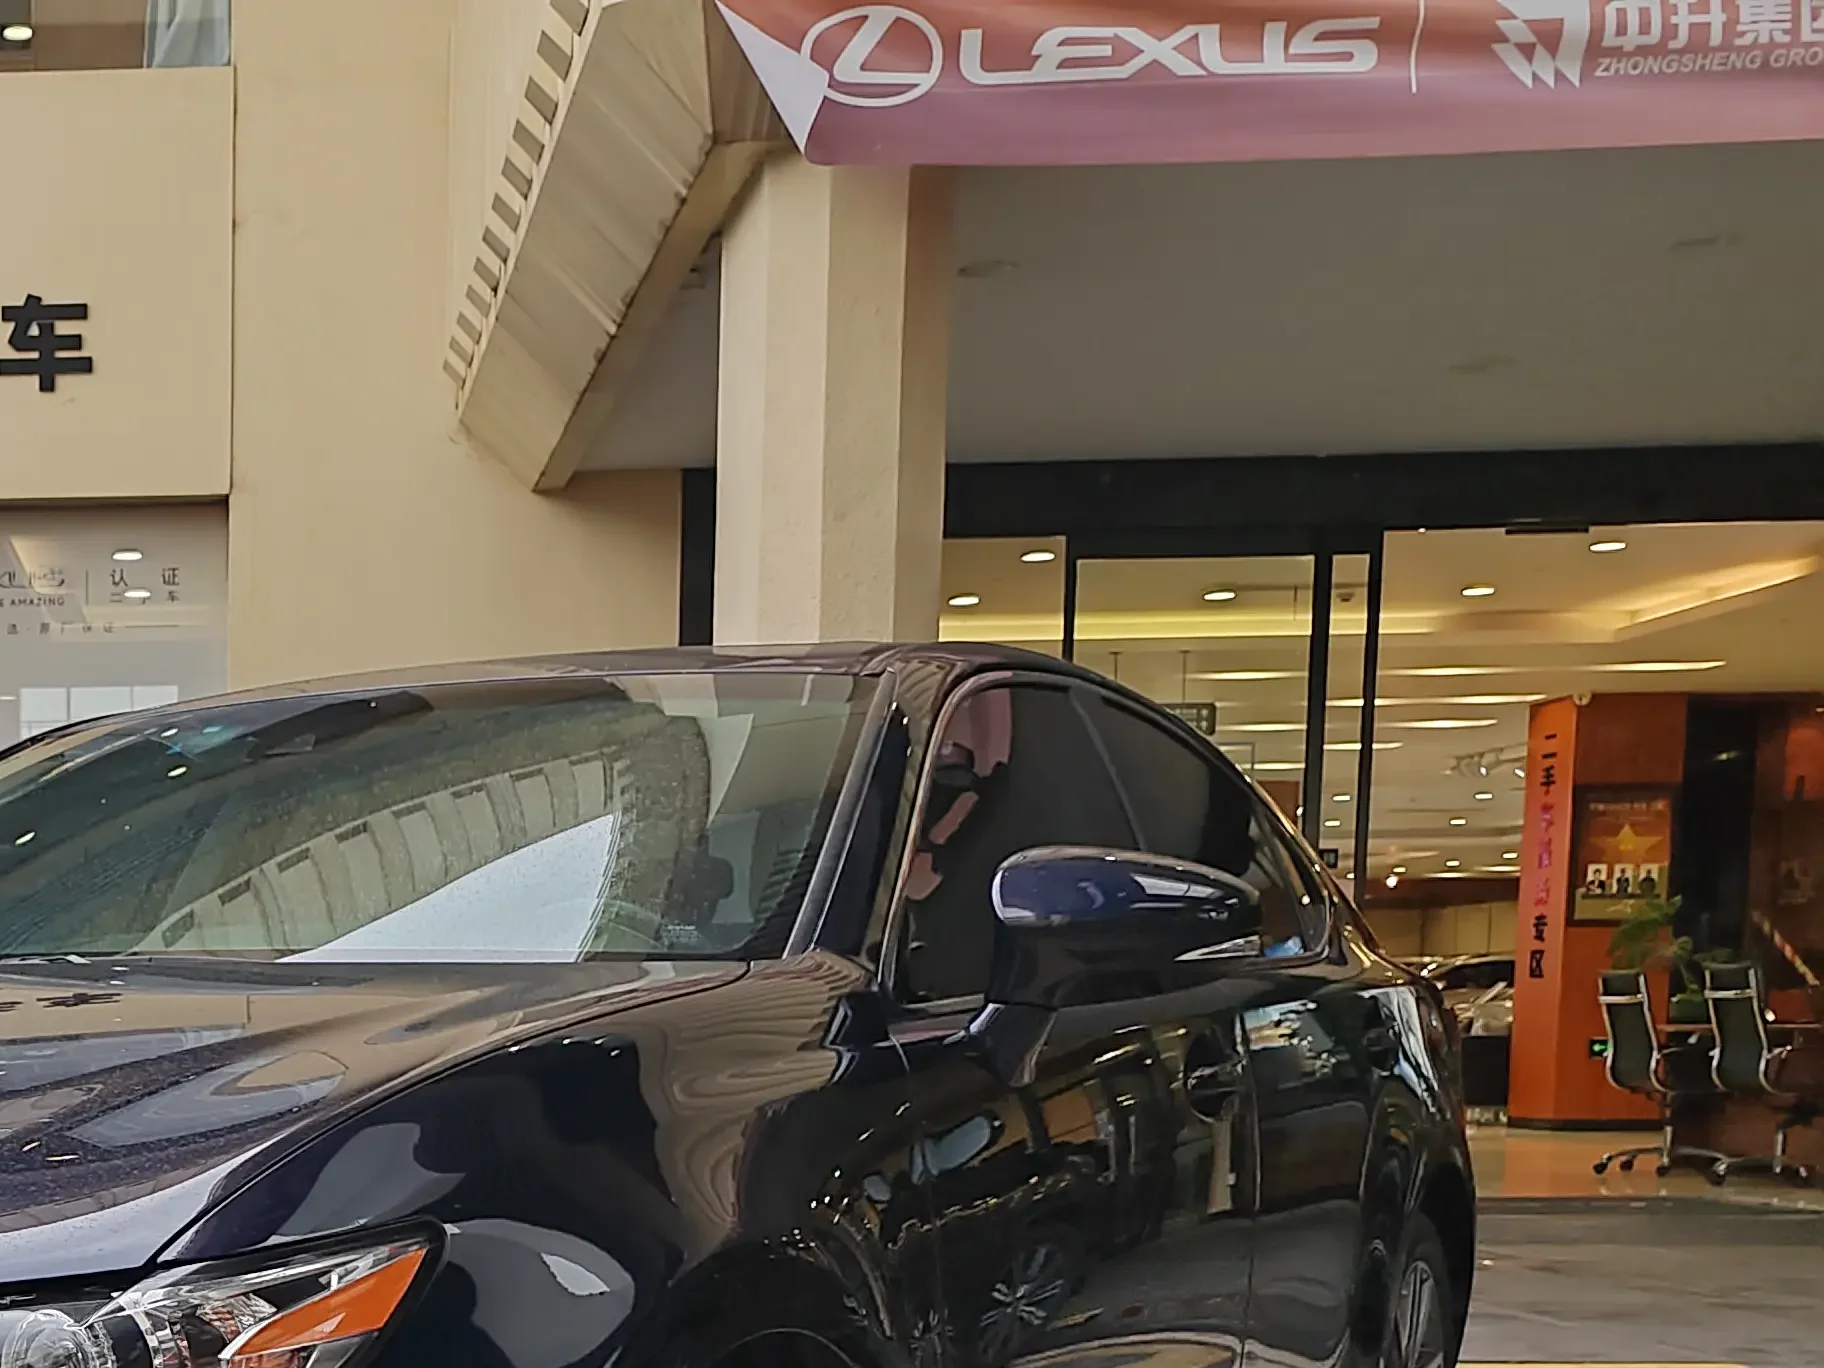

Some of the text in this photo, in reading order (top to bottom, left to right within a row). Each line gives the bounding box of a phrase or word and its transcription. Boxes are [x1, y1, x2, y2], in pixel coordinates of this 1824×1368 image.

[959, 16, 1379, 86] LEXUS
[1594, 47, 1824, 77] ZHONGSHENG GRO
